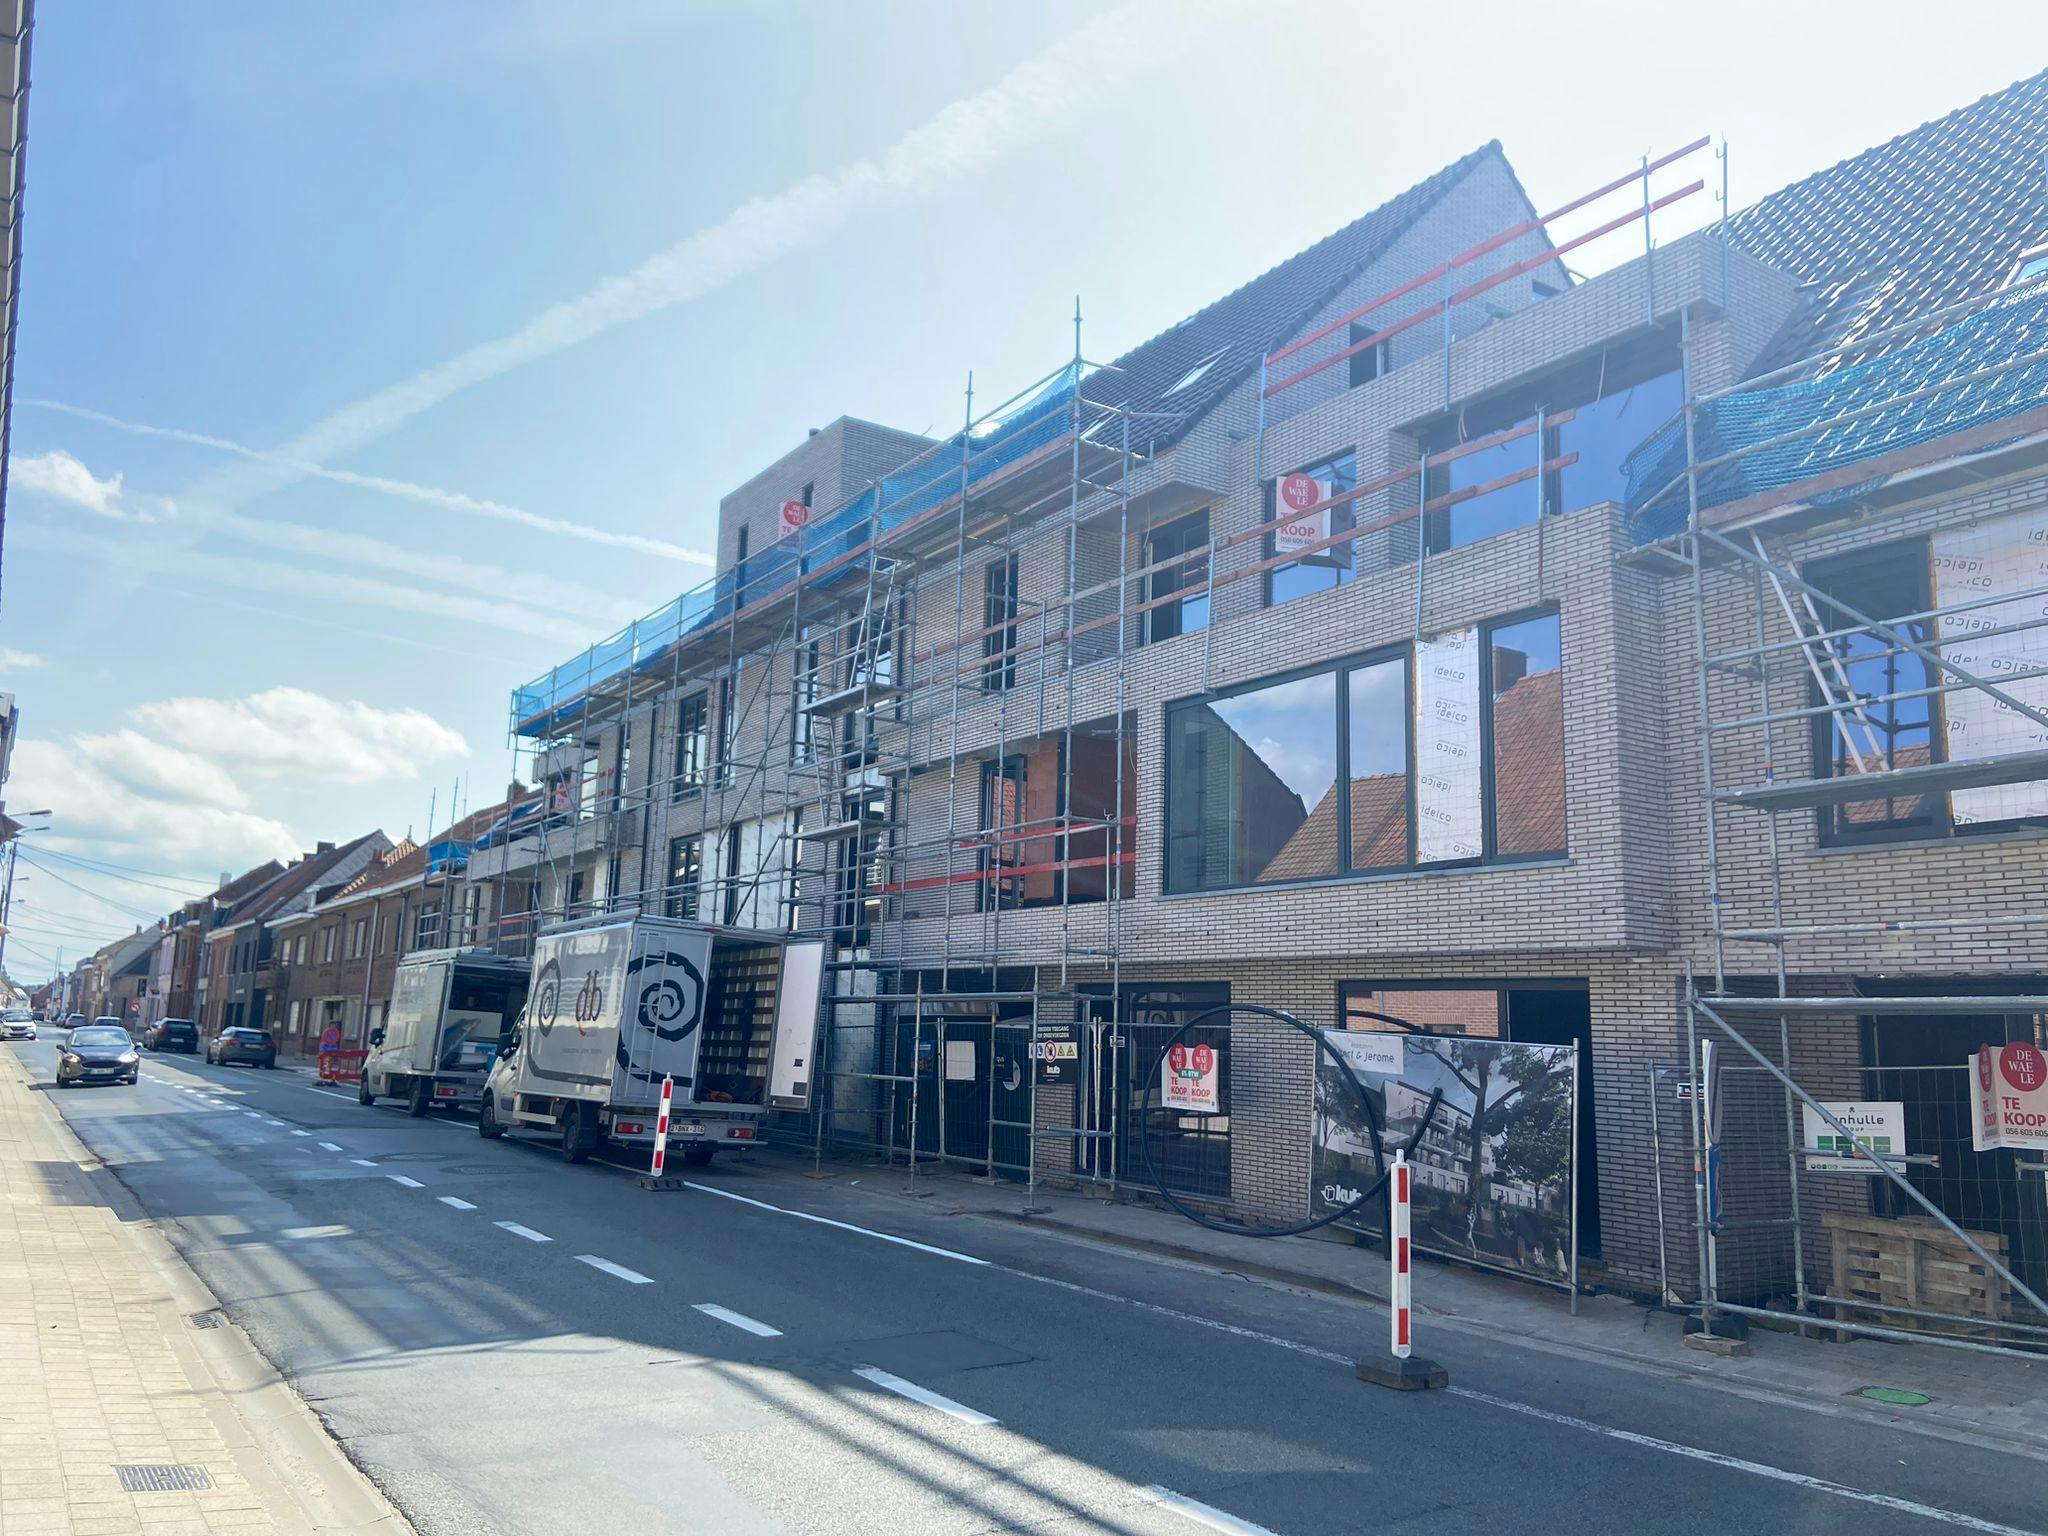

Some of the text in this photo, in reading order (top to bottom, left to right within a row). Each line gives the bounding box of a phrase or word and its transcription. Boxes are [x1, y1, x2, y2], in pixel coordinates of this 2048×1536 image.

[1296, 479, 1309, 487] DE
[1288, 487, 1309, 496] WAE
[1297, 497, 1309, 505] LE
[1280, 526, 1315, 537] KOOP
[1434, 664, 1466, 680] idelco
[1436, 706, 1468, 722] idelco
[1421, 804, 1452, 822] idelco
[2016, 1049, 2033, 1061] DE
[2008, 1060, 2034, 1073] WAE
[1171, 1077, 1178, 1086] TE
[1192, 1078, 1200, 1088] TE
[2020, 1073, 2035, 1085] LE
[1171, 1086, 1188, 1095] KOOP
[1192, 1088, 1211, 1097] KOOP
[2002, 1096, 2021, 1110] TE
[2004, 1112, 2047, 1127] KOOP
[2005, 1127, 2019, 1135] 056
[2019, 1128, 2034, 1136] 605
[2034, 1129, 2048, 1137] 605
